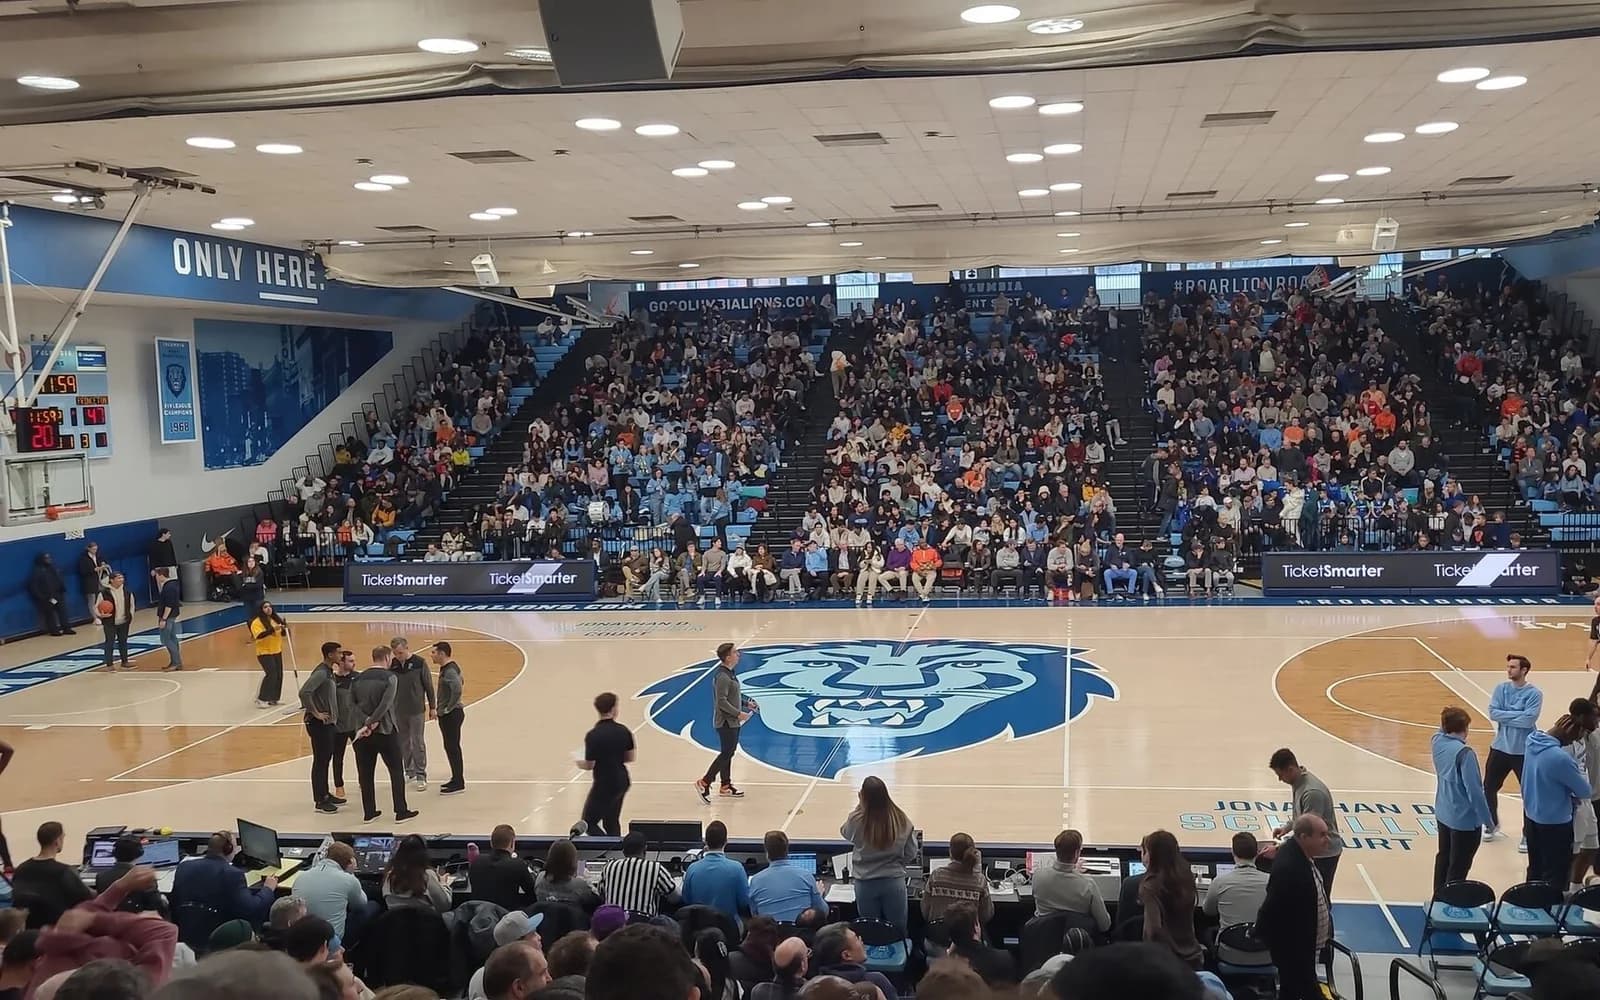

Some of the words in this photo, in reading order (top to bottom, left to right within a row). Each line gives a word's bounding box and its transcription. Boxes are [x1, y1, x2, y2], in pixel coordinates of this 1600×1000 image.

[173, 237, 243, 281] ONLY
[255, 250, 325, 290] HERE.
[1174, 276, 1312, 295] #ROARLIONROA
[169, 421, 190, 432] 1968
[32, 425, 54, 448] 20
[1282, 564, 1385, 579] TicketSmarter
[361, 573, 449, 588] TicketSmarter
[489, 572, 578, 587] TicketSmarter
[1213, 800, 1402, 814] JONAHAN
